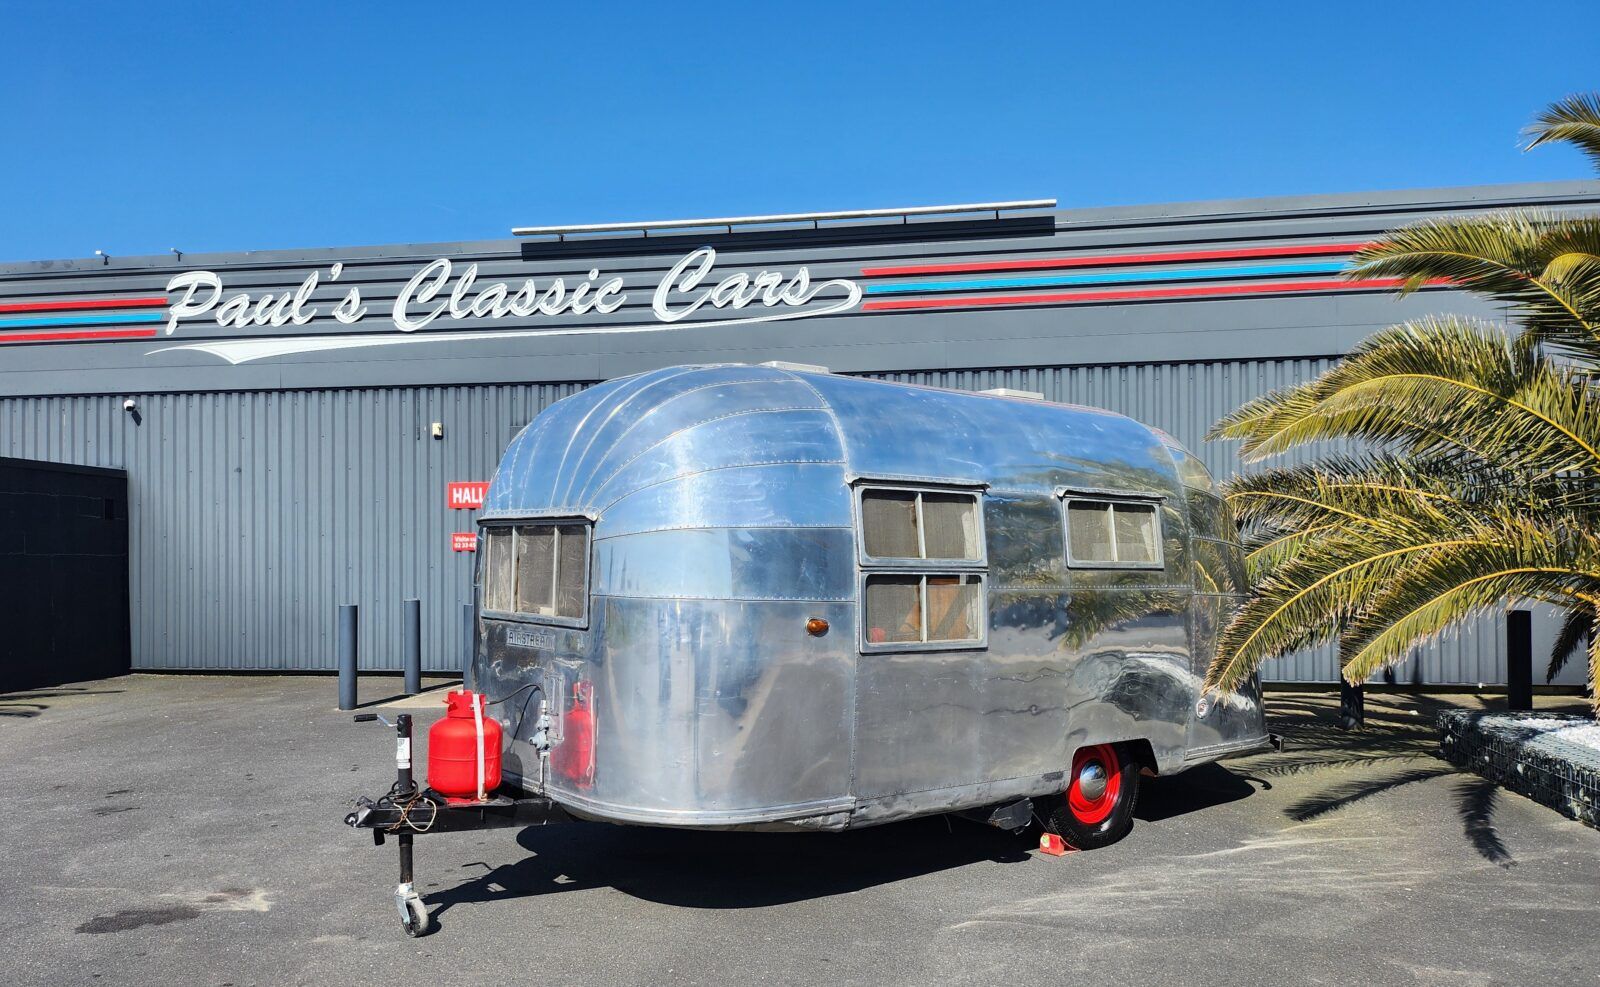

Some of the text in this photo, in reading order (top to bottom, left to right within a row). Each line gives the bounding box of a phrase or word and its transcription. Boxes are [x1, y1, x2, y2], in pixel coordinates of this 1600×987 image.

[166, 246, 811, 335] Paul's Classic Cars
